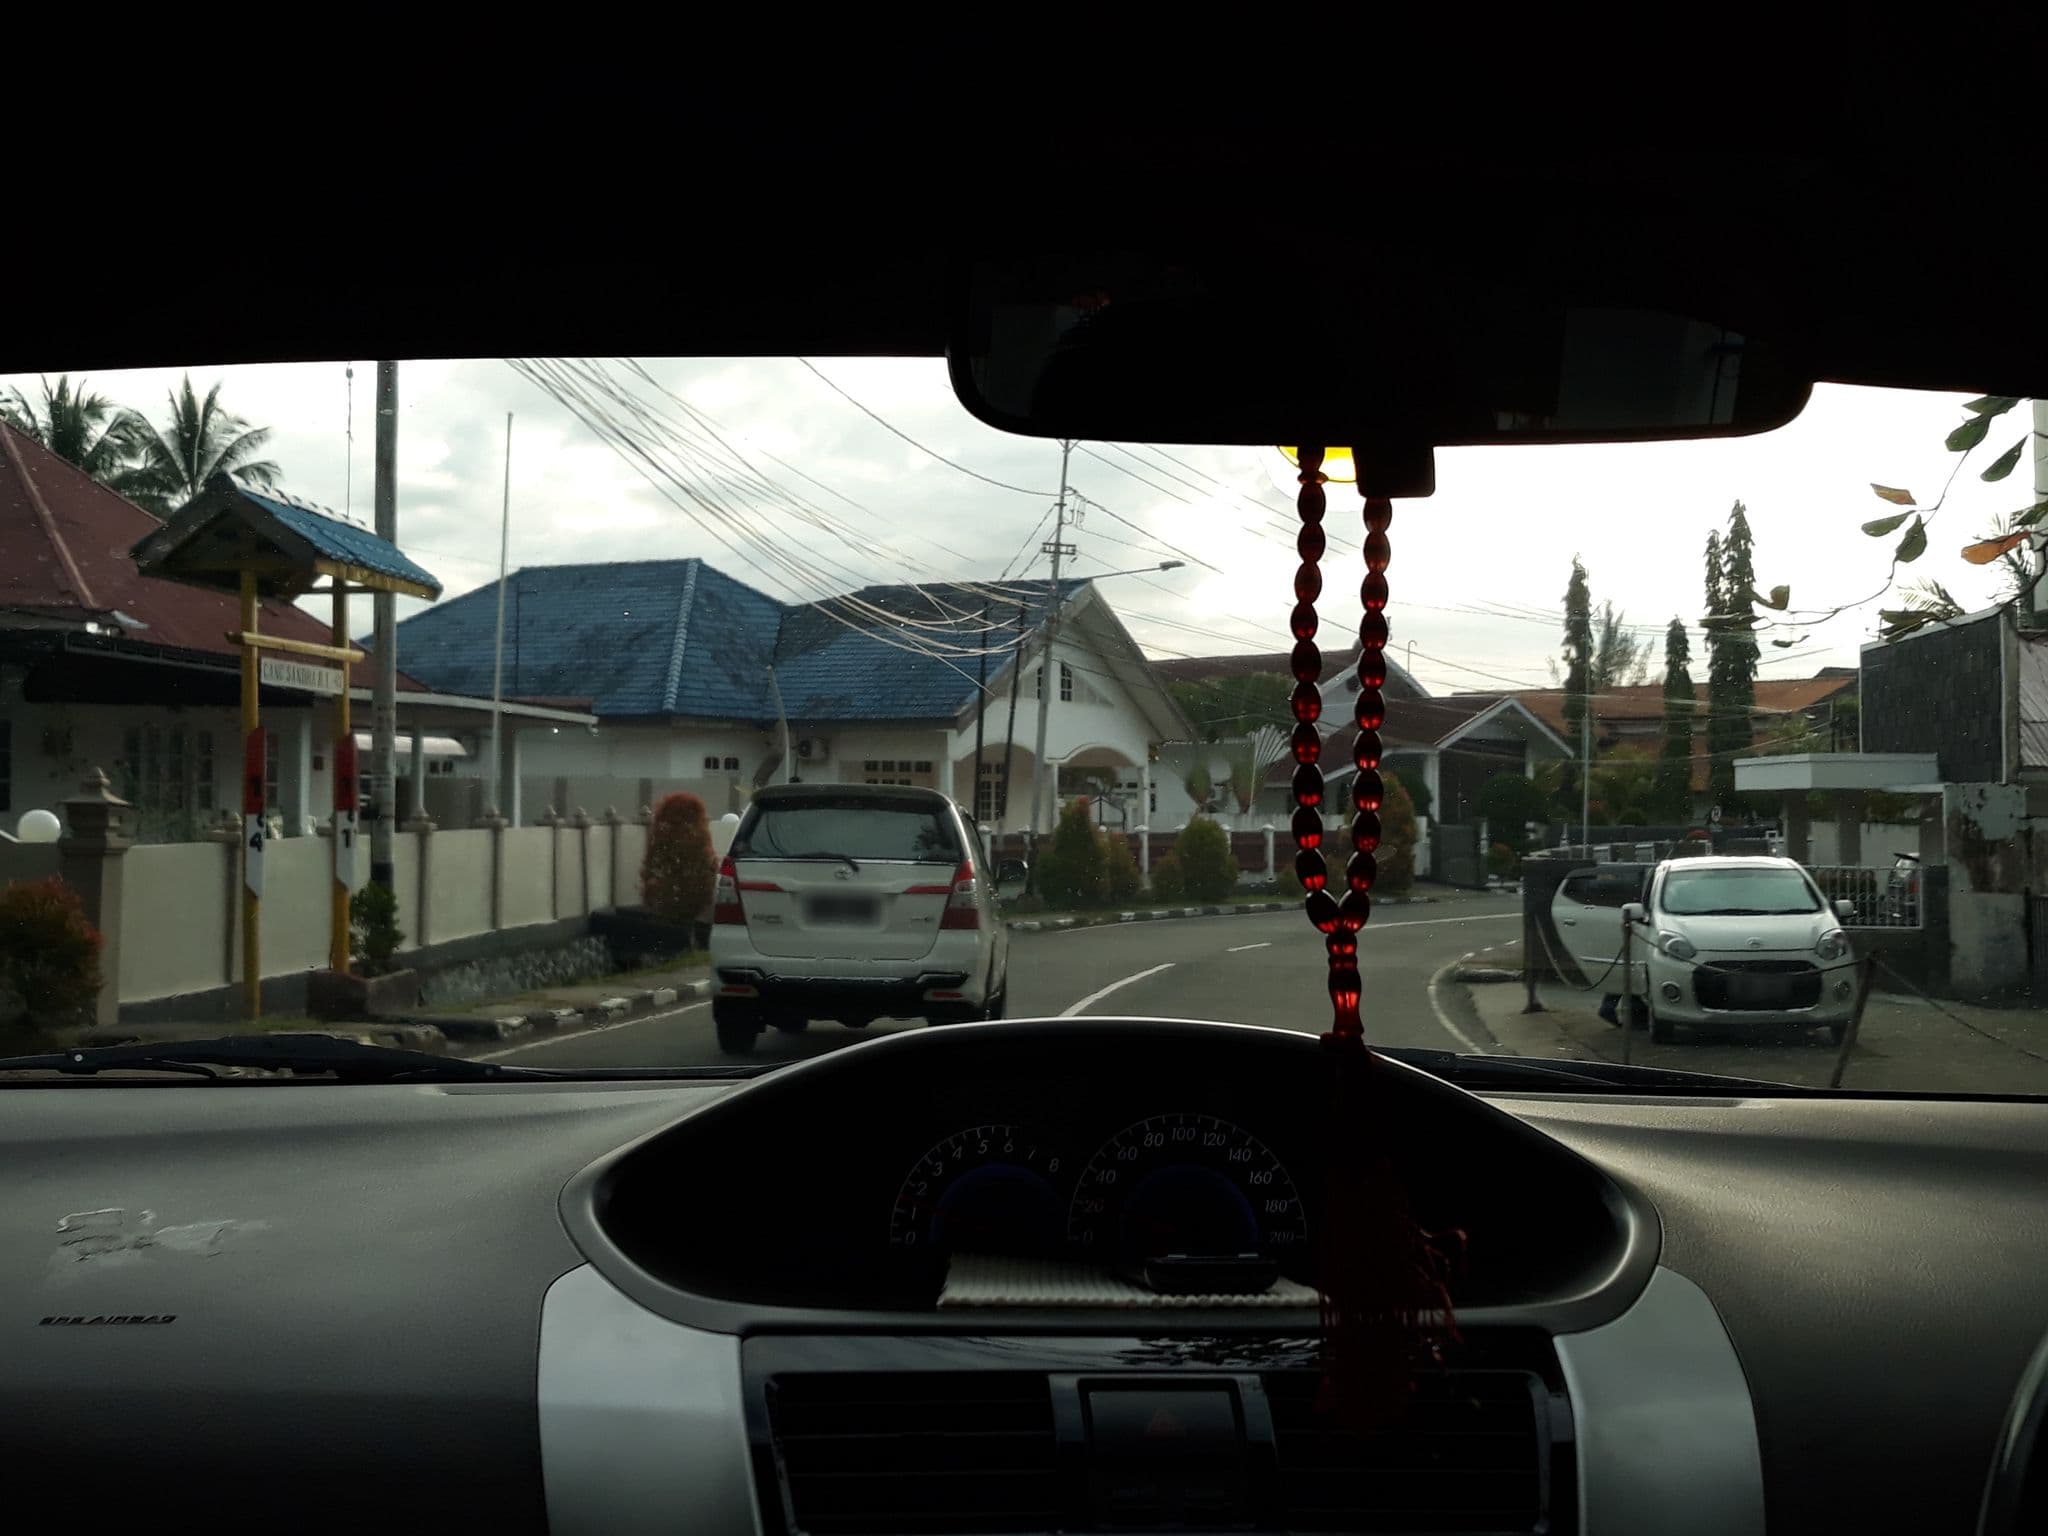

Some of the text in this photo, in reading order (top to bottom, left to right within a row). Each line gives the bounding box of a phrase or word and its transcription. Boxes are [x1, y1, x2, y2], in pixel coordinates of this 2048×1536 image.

[1143, 1132, 1164, 1146] 80
[1170, 1127, 1196, 1141] 100
[1202, 1132, 1226, 1146] 120
[951, 1144, 962, 1160] 4
[977, 1139, 989, 1154] 5
[1003, 1138, 1014, 1153] 6
[1116, 1147, 1137, 1161] 60
[1228, 1147, 1252, 1162] 140
[933, 1161, 944, 1177] 3
[1050, 1158, 1060, 1174] 8
[1097, 1170, 1116, 1184] 40
[1248, 1170, 1273, 1185] 160
[918, 1182, 928, 1197] 2
[1264, 1199, 1288, 1214] 180
[904, 1231, 917, 1247] 0
